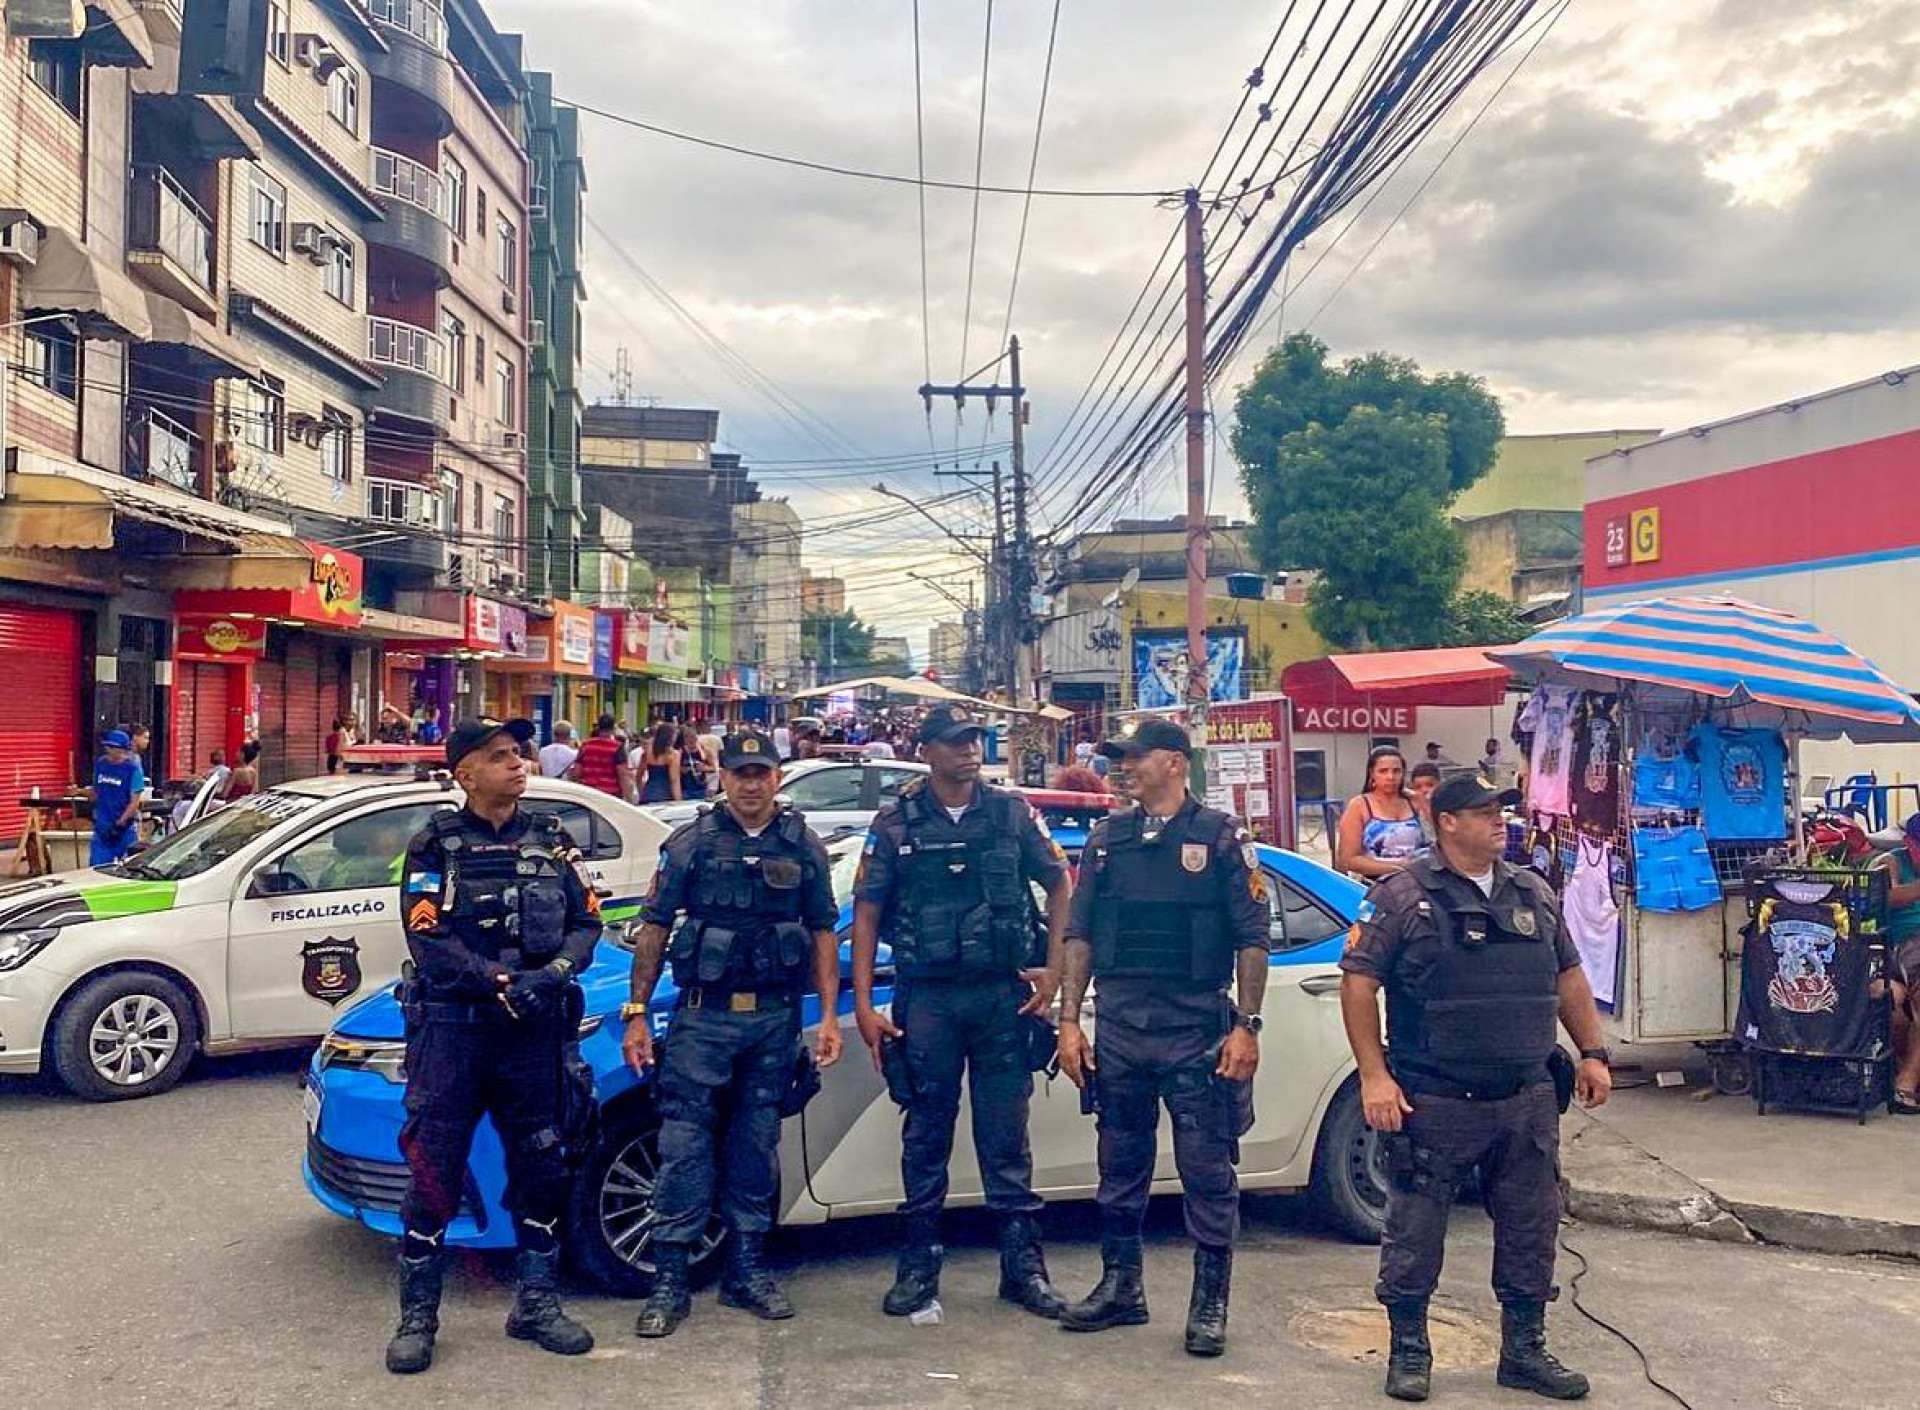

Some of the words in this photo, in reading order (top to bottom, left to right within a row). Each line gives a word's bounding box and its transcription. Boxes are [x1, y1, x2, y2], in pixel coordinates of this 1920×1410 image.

[1607, 527, 1624, 552] 23
[1636, 515, 1655, 554] G
[270, 899, 385, 922] FISCALIZAÇÃO
